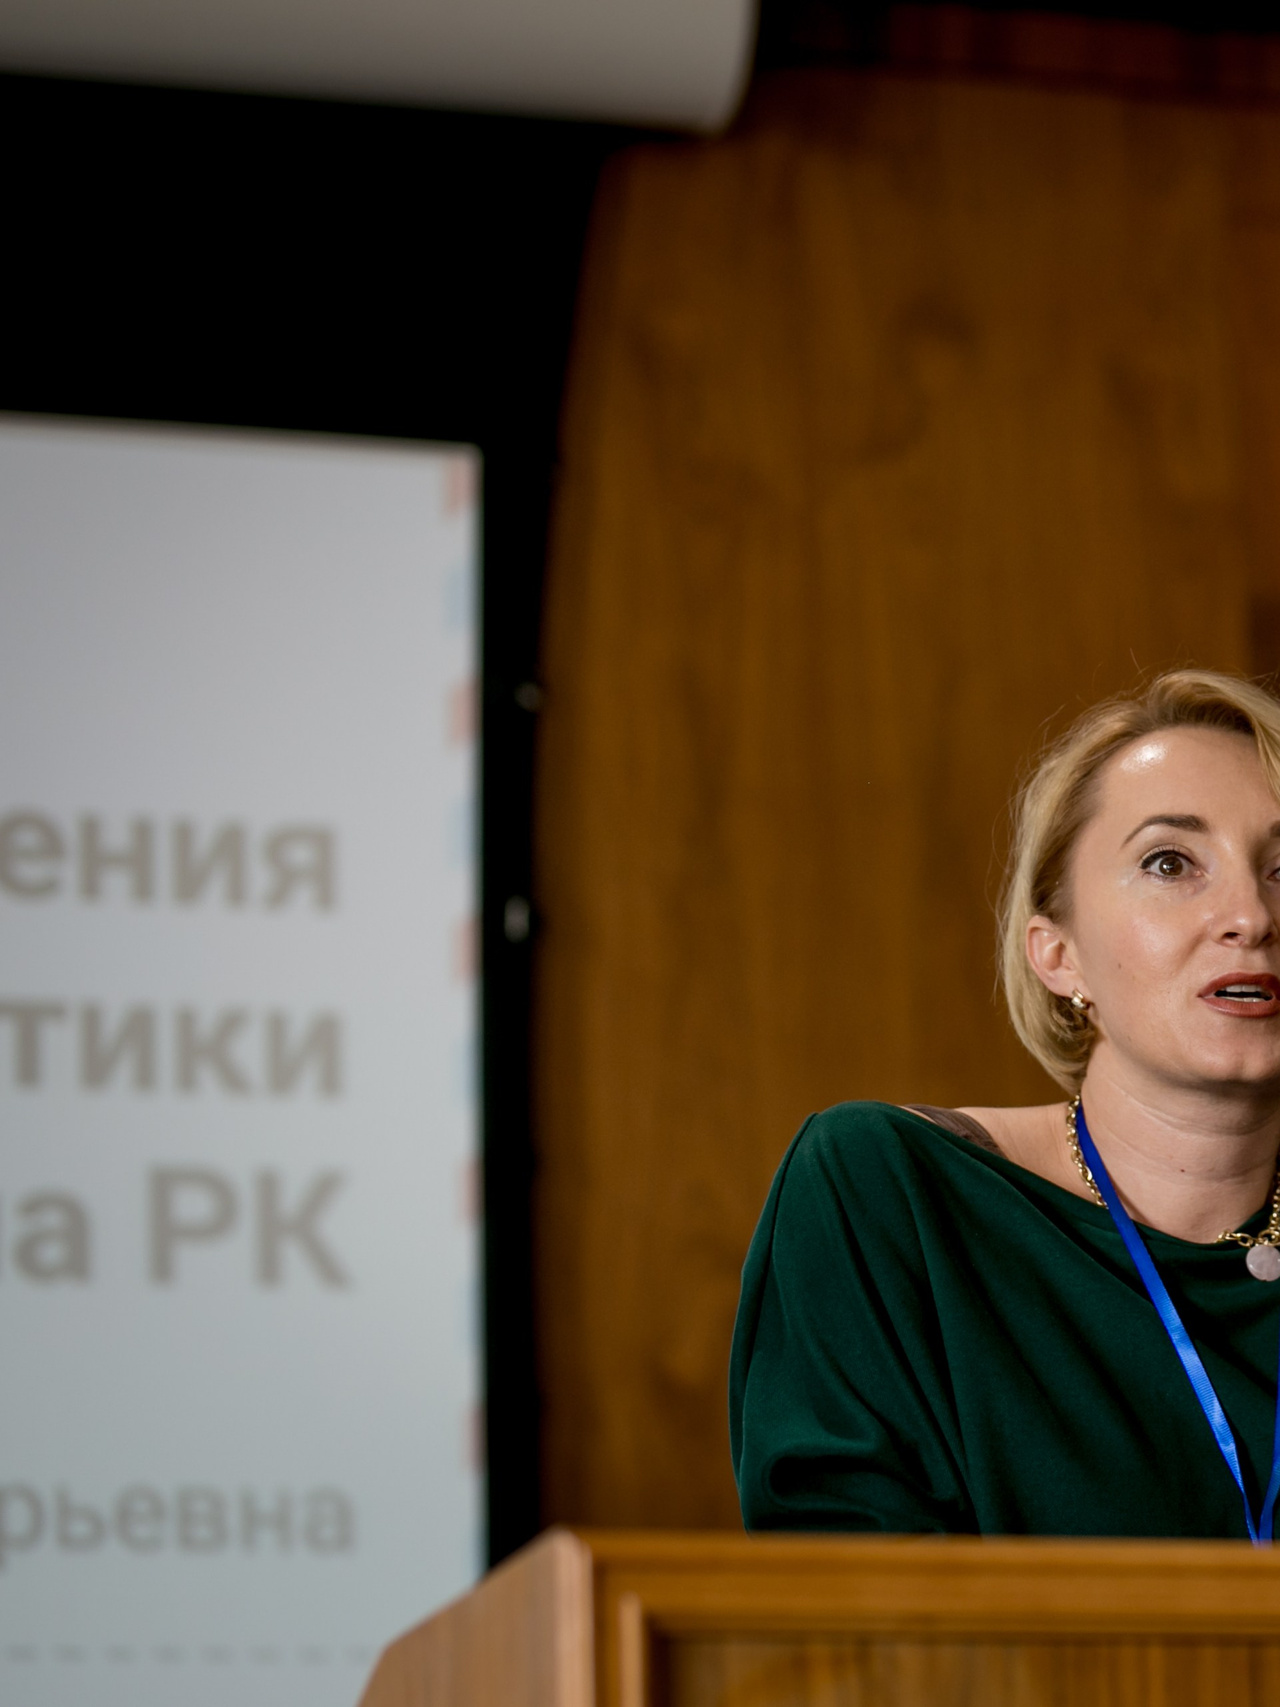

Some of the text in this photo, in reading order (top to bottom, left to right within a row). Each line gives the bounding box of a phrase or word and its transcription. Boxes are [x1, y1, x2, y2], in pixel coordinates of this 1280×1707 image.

[0, 806, 337, 912] ения
[0, 997, 344, 1099] тики
[0, 1163, 351, 1290] а РК
[0, 1482, 356, 1575] рьевна
